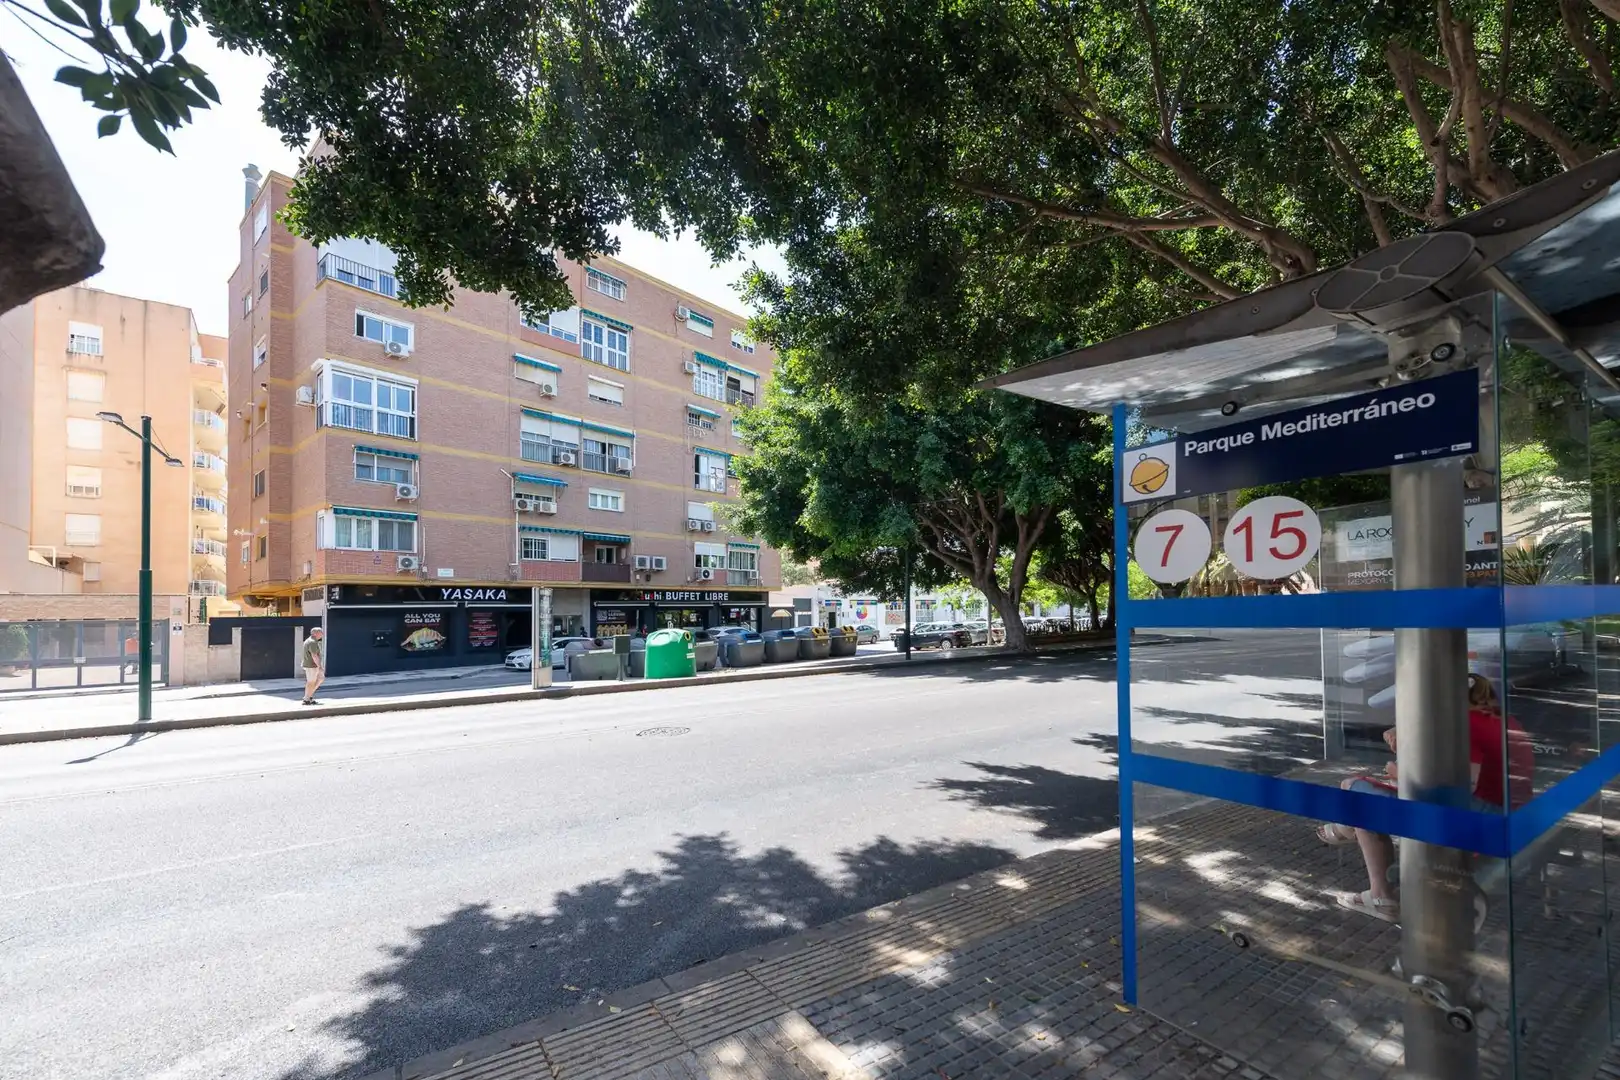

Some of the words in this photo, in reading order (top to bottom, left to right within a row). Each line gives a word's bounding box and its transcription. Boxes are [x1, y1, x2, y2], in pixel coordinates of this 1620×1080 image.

[1184, 432, 1255, 456] Parque
[1261, 393, 1436, 441] Mediterráneo
[1155, 524, 1184, 567] 7
[1233, 510, 1307, 562] 15
[441, 588, 507, 600] YASAKA
[665, 591, 701, 600] BUFFET
[705, 592, 729, 601] LIBRE
